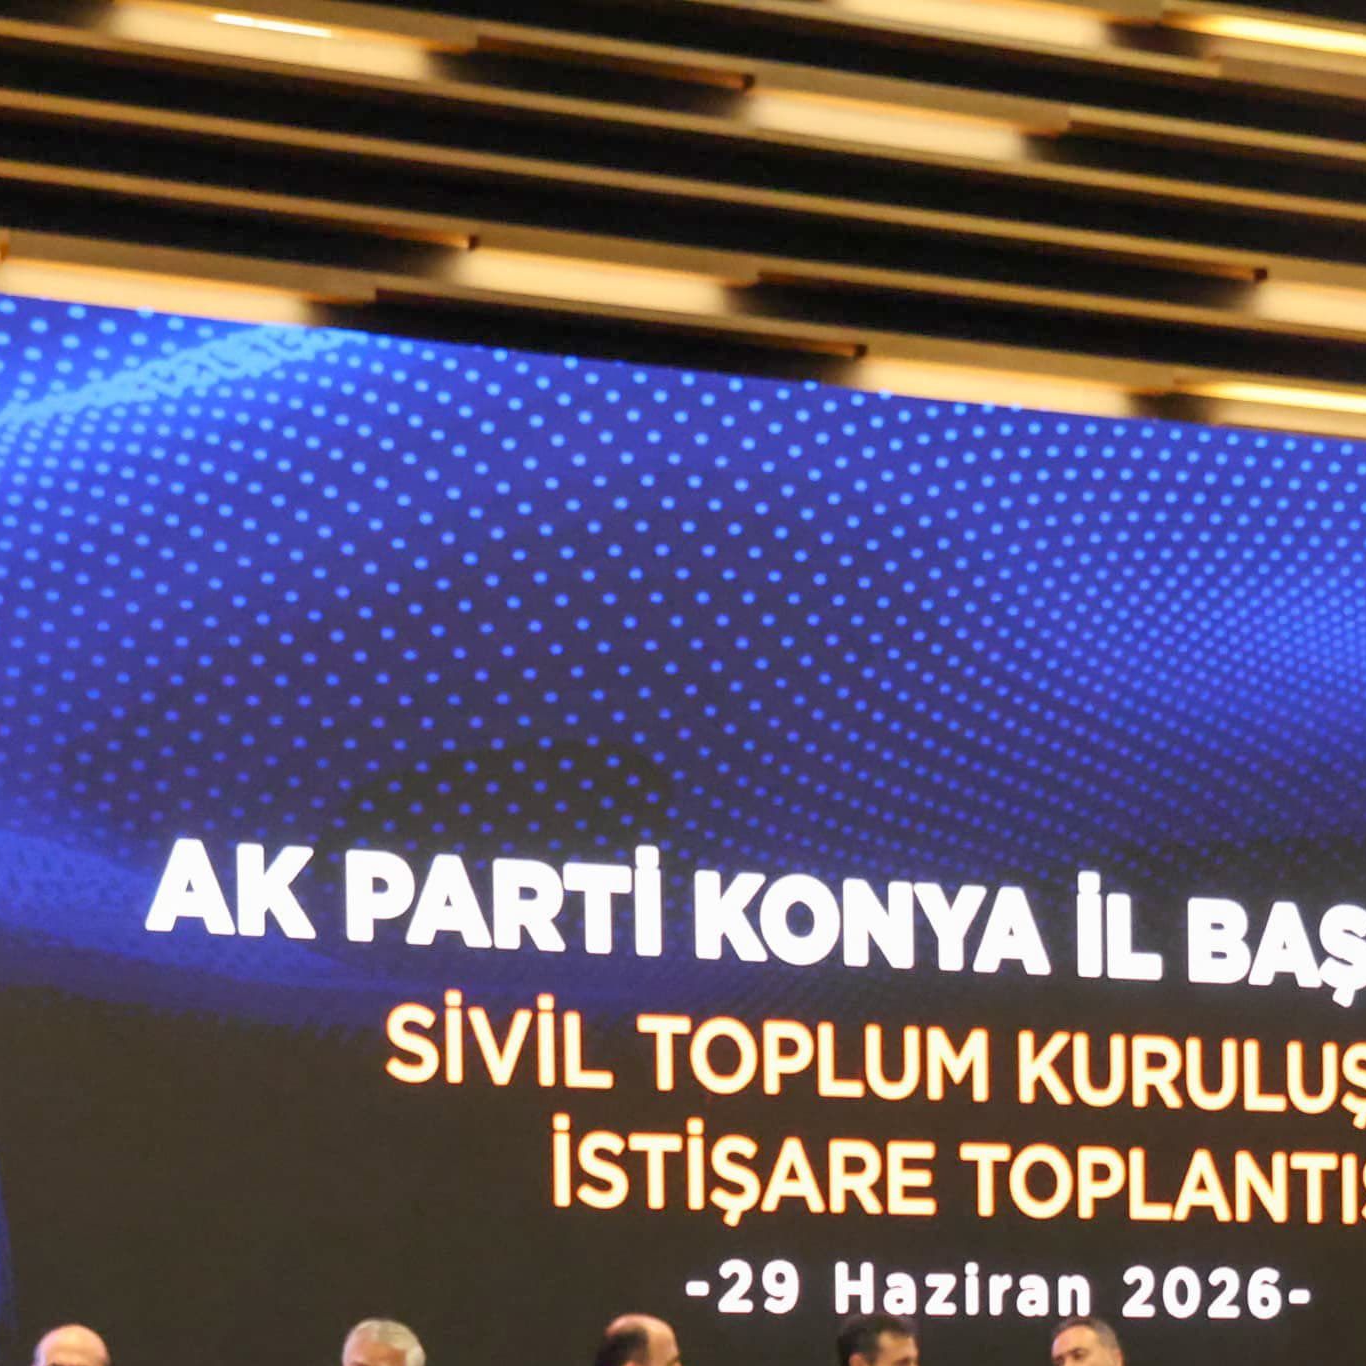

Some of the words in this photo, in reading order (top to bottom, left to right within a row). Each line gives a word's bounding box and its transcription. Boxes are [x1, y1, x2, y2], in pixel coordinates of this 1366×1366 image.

[143, 837, 317, 940] AK
[344, 844, 664, 957] PARTİ
[693, 869, 1053, 976] KONYA
[1075, 870, 1164, 982] İL
[384, 987, 615, 1090] SİVİL
[635, 1013, 991, 1104] TOPLUM
[551, 1112, 939, 1227] İSTİŞARE
[684, 1258, 801, 1315] -29
[833, 1261, 1092, 1318] Haziran
[1121, 1265, 1312, 1320] 2026-
